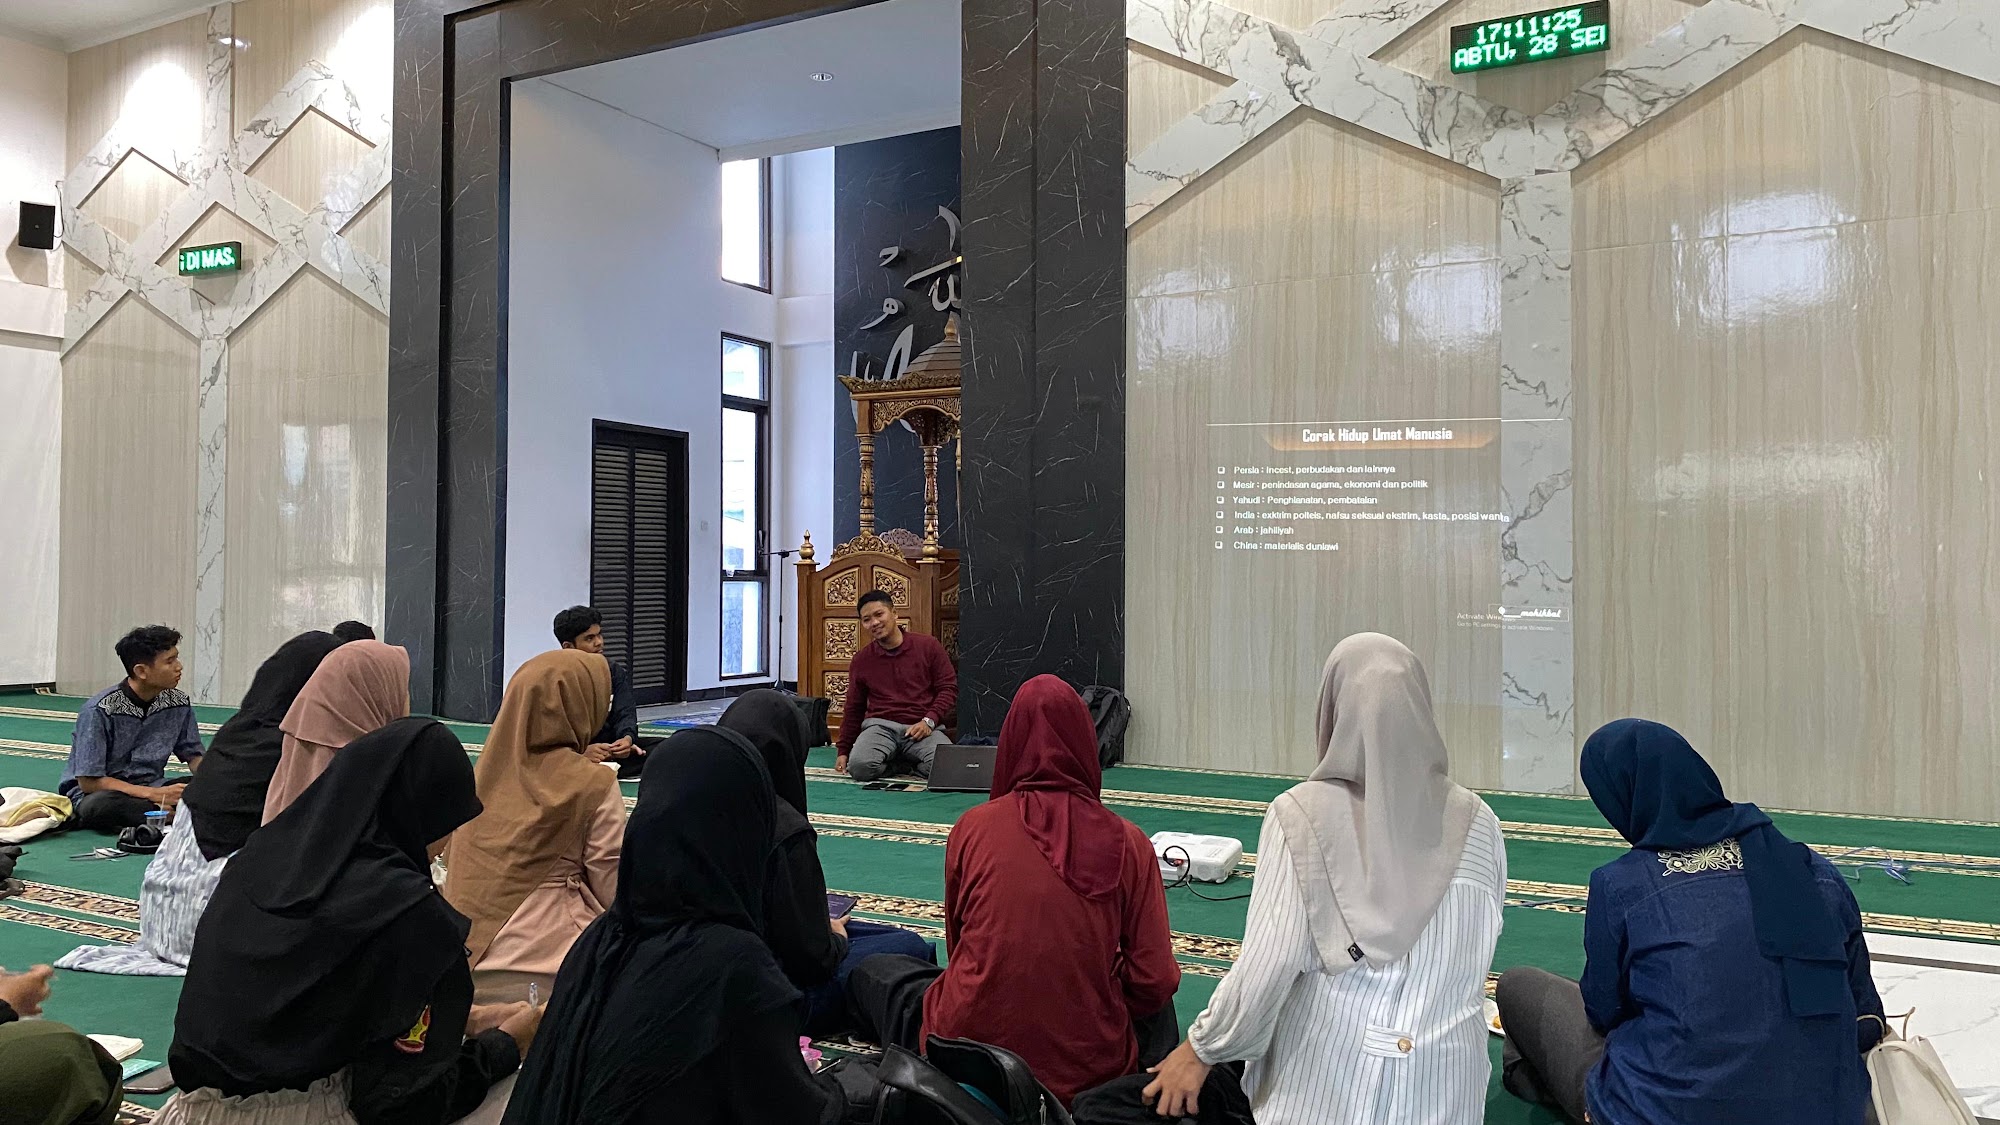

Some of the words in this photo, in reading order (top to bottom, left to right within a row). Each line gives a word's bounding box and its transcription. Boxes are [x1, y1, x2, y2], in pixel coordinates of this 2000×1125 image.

[1476, 7, 1582, 45] 17:11:25
[1454, 41, 1516, 68] ABTU,
[1528, 33, 1558, 56] 28
[1570, 24, 1606, 49] SE
[186, 251, 200, 271] DI
[201, 246, 236, 269] MAS
[1302, 428, 1336, 443] Corak
[1338, 428, 1369, 444] Hidup
[1372, 427, 1402, 441] Umat
[1405, 426, 1453, 441] Manusia
[1233, 466, 1260, 474] Persia
[1266, 466, 1294, 475] Incest,
[1296, 465, 1345, 475] perbudakan
[1346, 465, 1363, 473] dan
[1364, 465, 1396, 474] lainnya
[1233, 481, 1255, 489] Mesir
[1261, 481, 1310, 490] penindasan
[1310, 482, 1342, 490] agama,
[1343, 480, 1381, 489] ekonomi
[1382, 480, 1400, 489] dan
[1400, 479, 1429, 489] politik
[1232, 496, 1261, 504] Yahudi
[1267, 496, 1326, 505] Penghianatan,
[1327, 496, 1378, 505] pembatalan
[1234, 511, 1255, 519] India
[1325, 511, 1350, 520] nafsu
[1351, 511, 1384, 520] seksual
[1385, 512, 1421, 521] ekstrim,
[1422, 512, 1450, 521] kasta,
[1451, 512, 1479, 521] posisi
[1233, 526, 1254, 534] Arab
[1260, 526, 1294, 535] jahiliyah
[1233, 541, 1258, 550] China
[1264, 542, 1305, 550] materialis
[1305, 542, 1339, 551] duniawi
[1456, 612, 1485, 620] Activate
